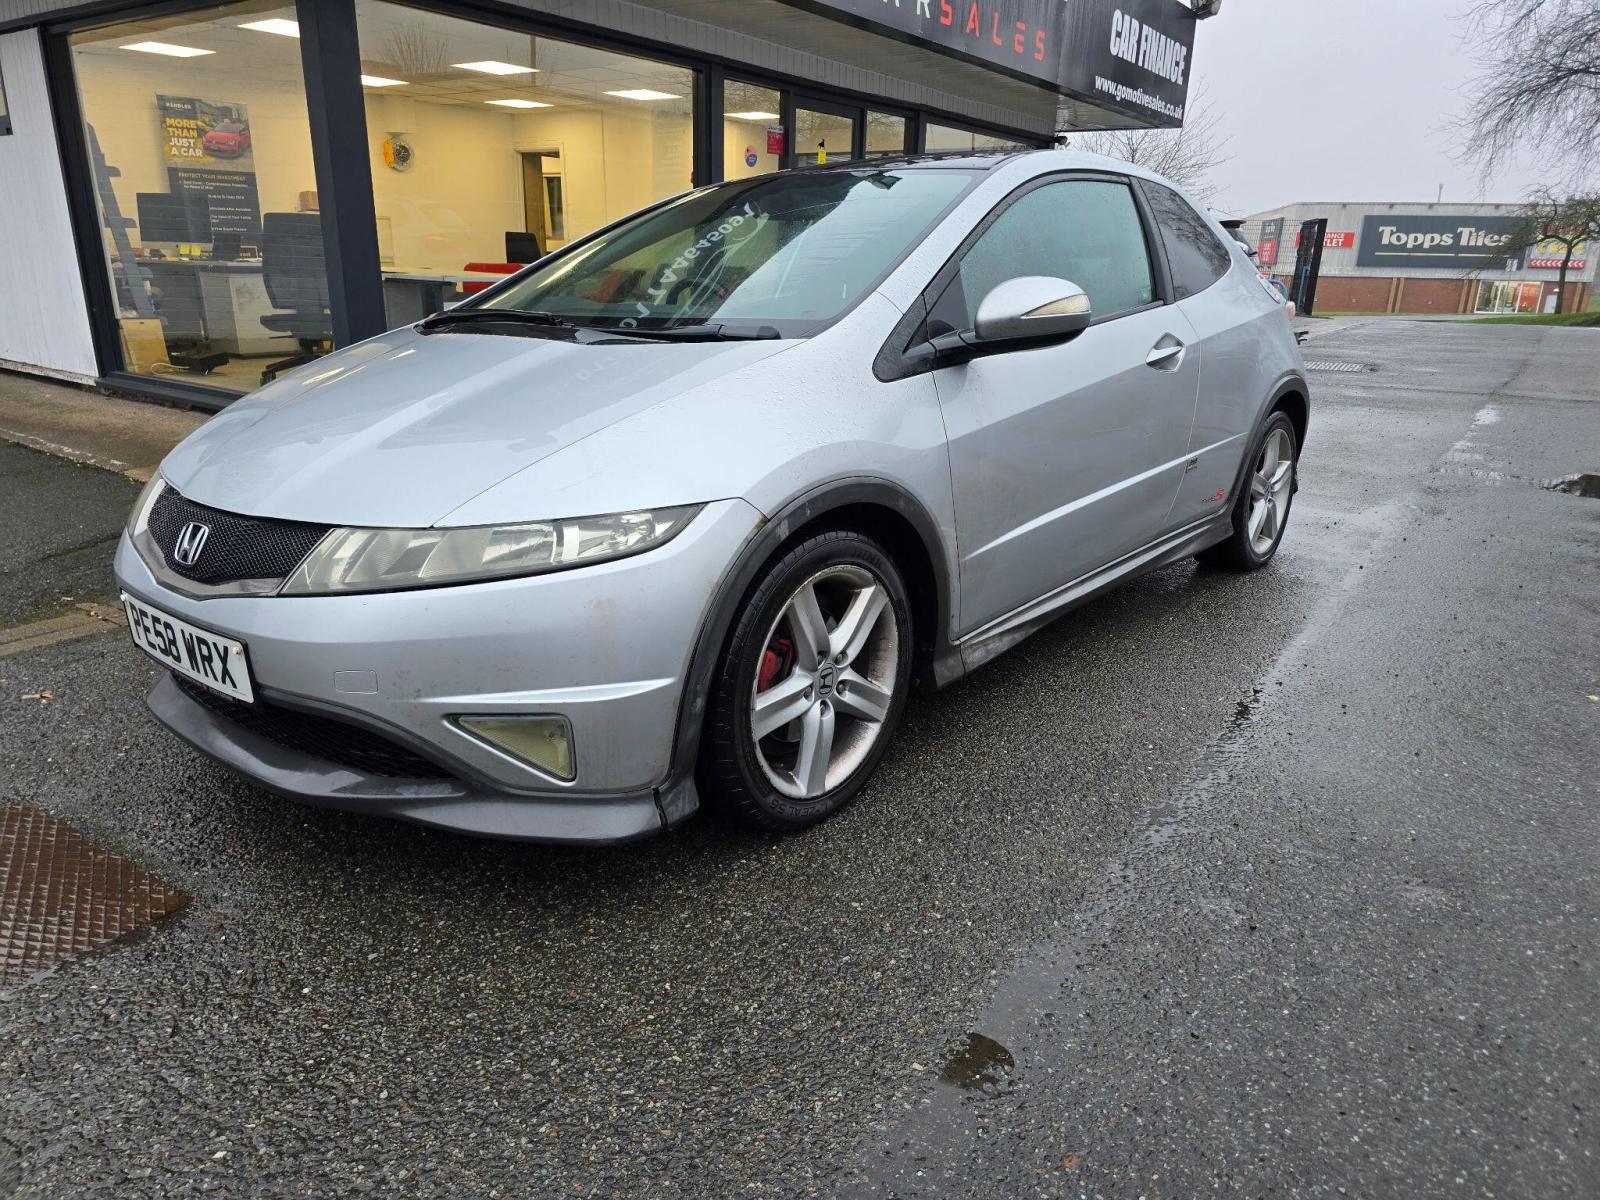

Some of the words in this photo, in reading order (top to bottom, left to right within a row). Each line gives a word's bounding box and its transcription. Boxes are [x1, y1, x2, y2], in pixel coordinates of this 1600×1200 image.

[1109, 9, 1140, 64] CAR
[1138, 23, 1187, 86] FINANCE
[1095, 75, 1184, 120] www.gomotivesales.co.uk
[165, 118, 198, 129] MORE
[167, 127, 198, 138] THAN
[169, 138, 196, 148] JUST
[171, 147, 179, 156] A
[180, 147, 203, 157] CAR
[1378, 226, 1454, 249] Topps
[128, 602, 182, 664] PE58
[180, 628, 238, 690] WRX
